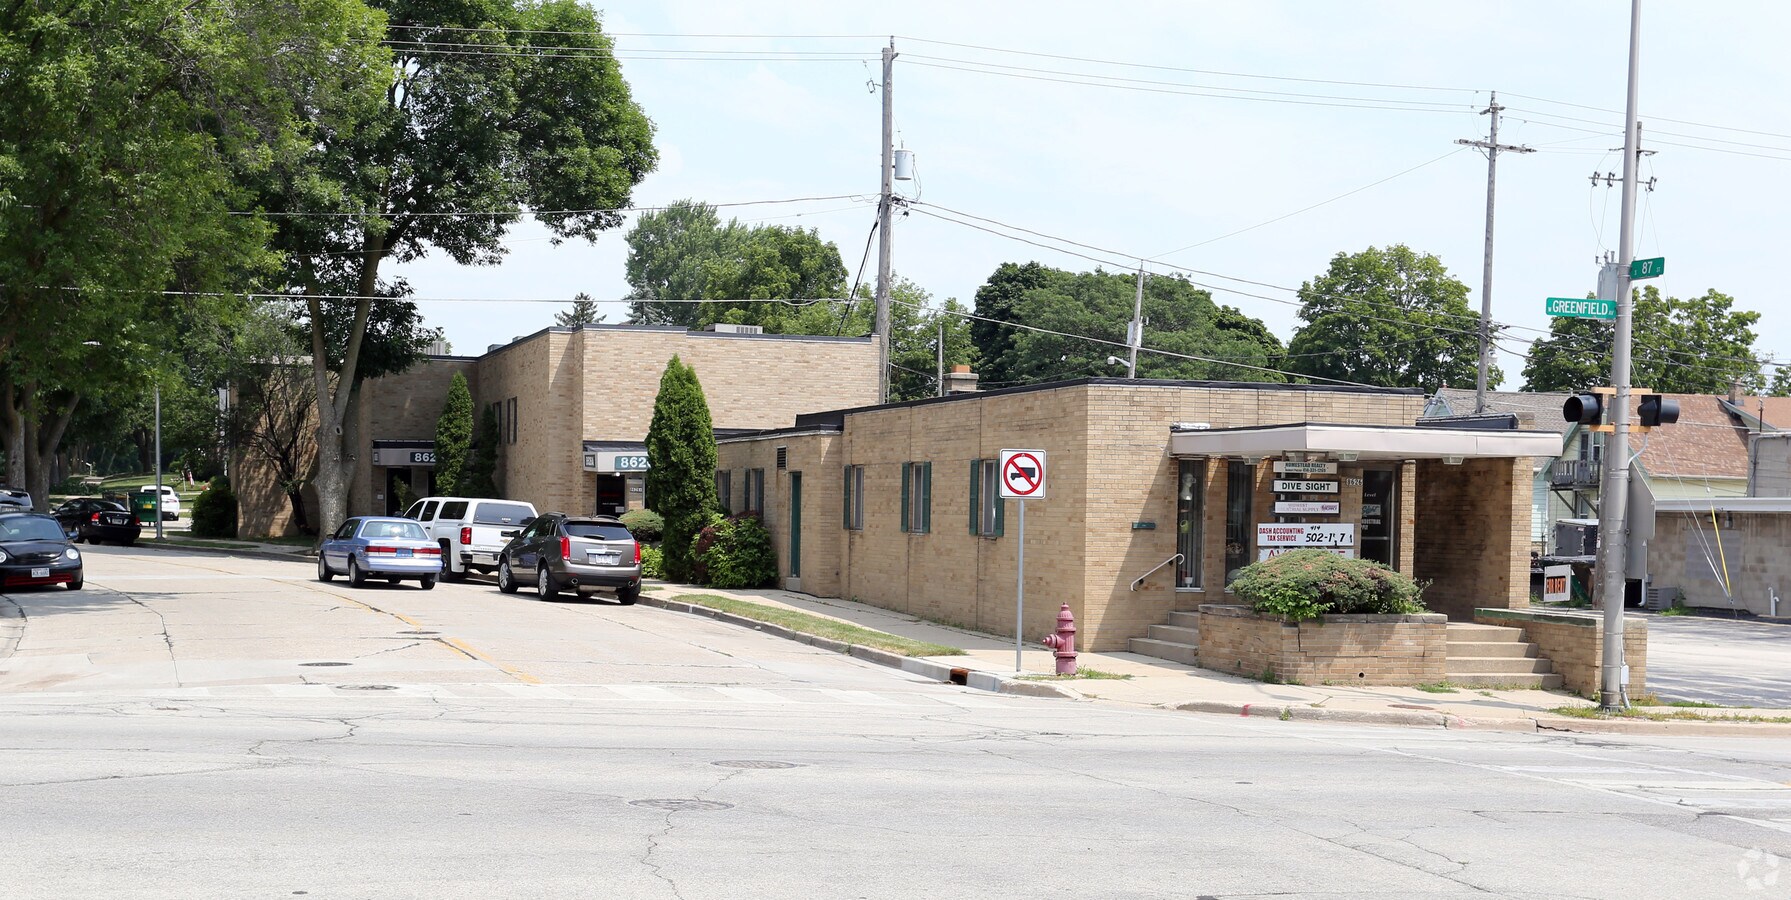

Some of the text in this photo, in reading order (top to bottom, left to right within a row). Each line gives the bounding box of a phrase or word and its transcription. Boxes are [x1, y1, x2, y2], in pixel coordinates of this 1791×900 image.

[1641, 261, 1653, 275] 87
[1552, 300, 1608, 315] GREENFIELD
[1282, 482, 1331, 490] DIVE SIGHT
[1273, 527, 1304, 535] ACCOUNTING
[1546, 577, 1565, 593] FOR RENT
